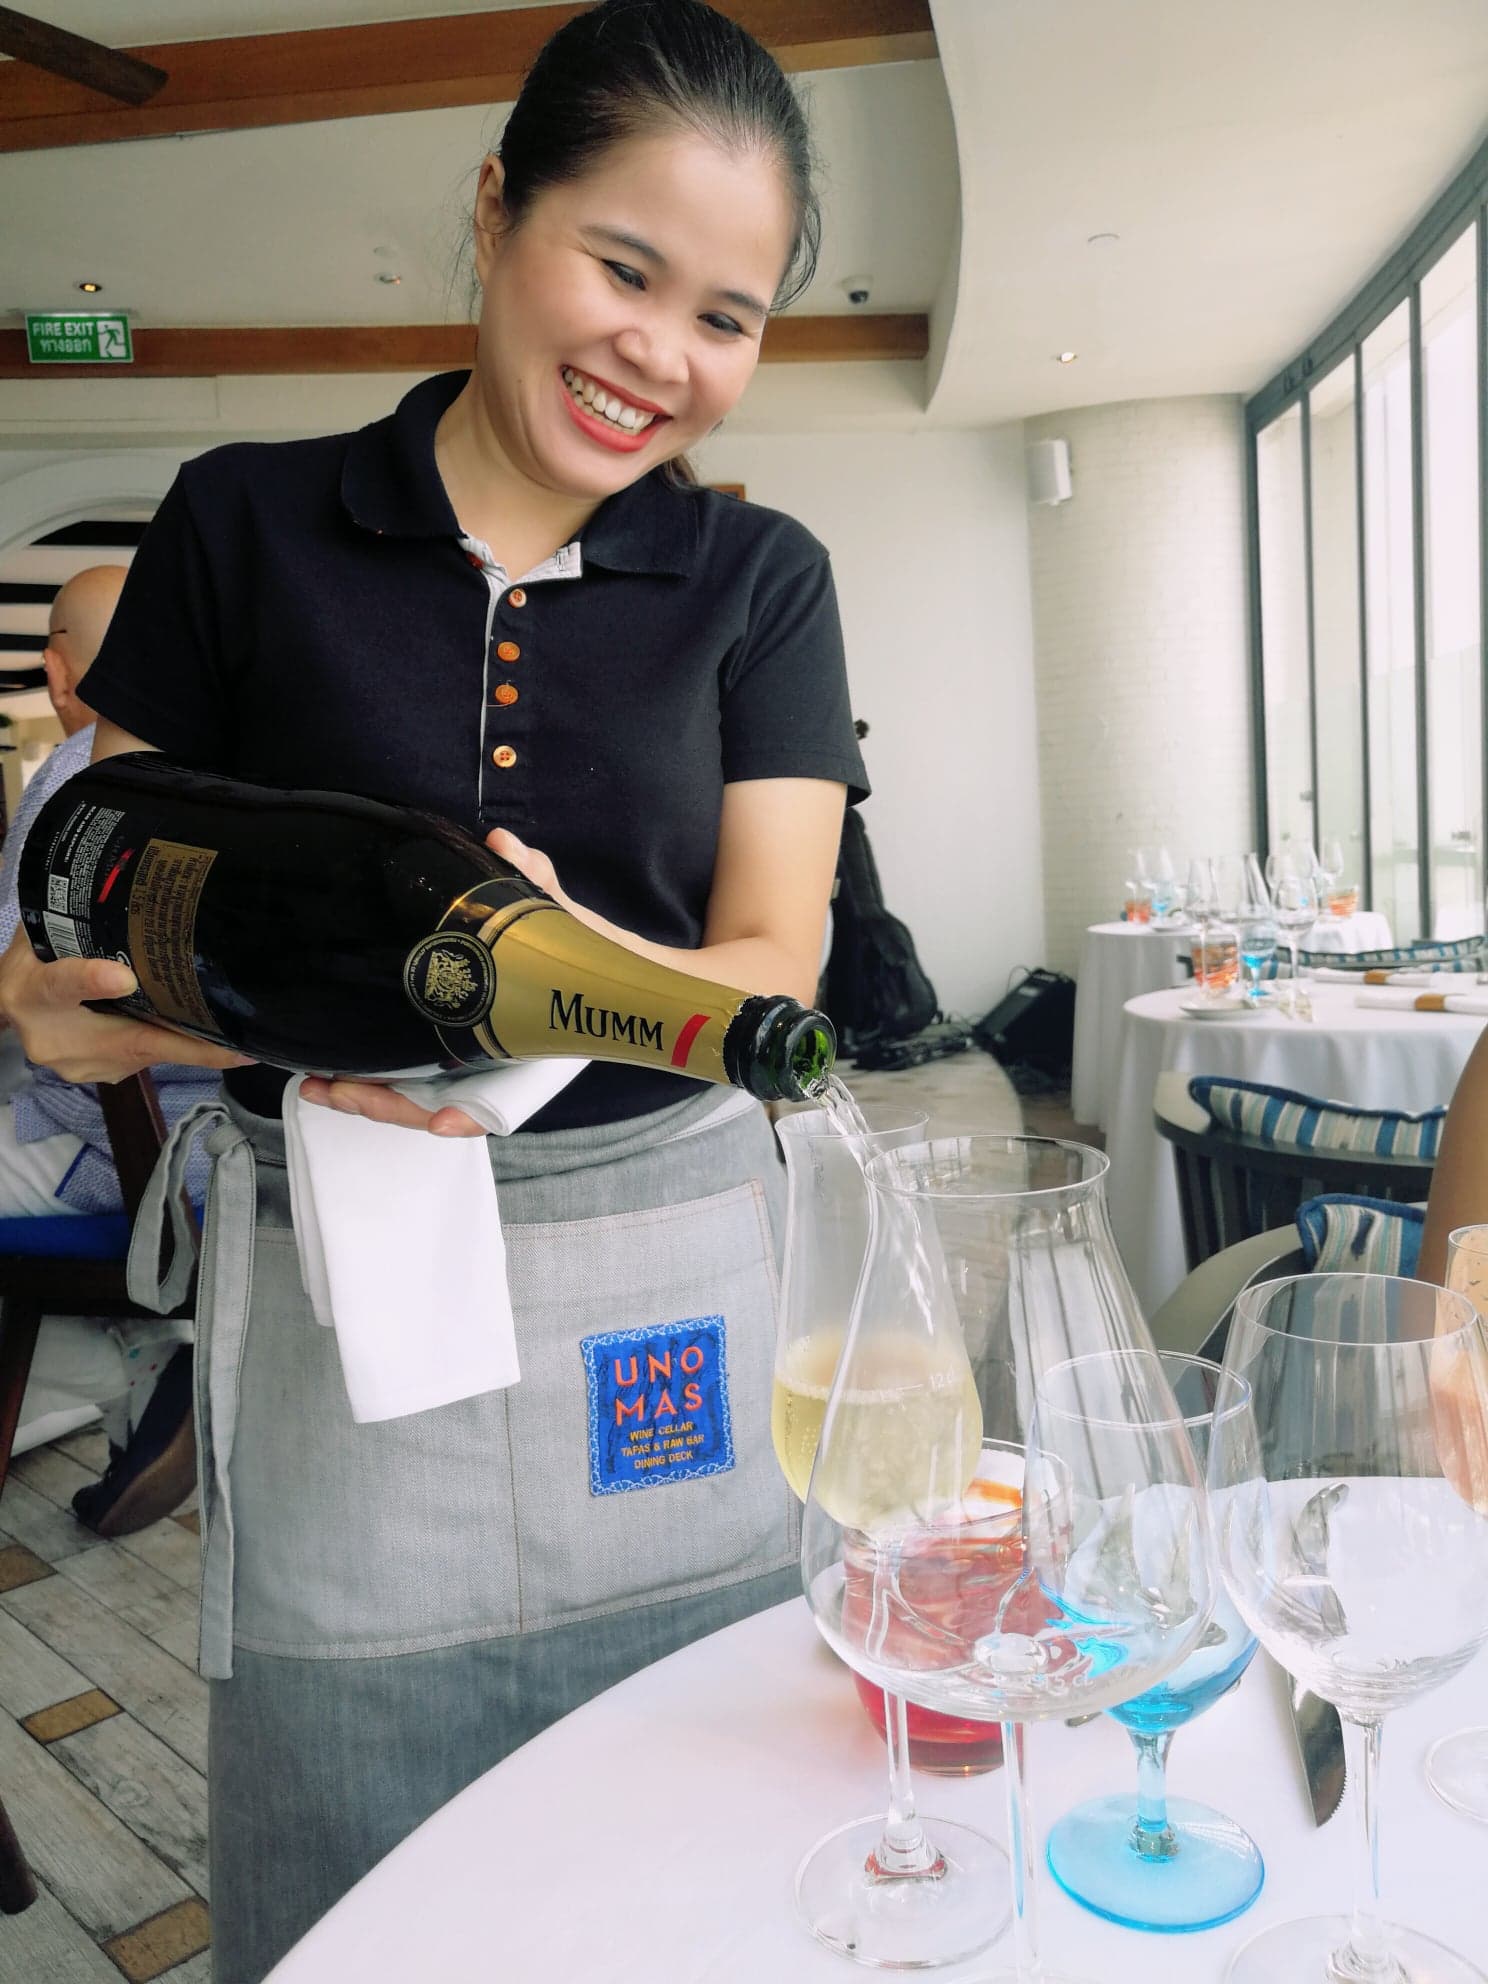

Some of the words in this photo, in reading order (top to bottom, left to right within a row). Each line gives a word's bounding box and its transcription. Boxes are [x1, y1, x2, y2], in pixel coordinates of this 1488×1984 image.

[32, 322, 62, 337] FIRE
[63, 322, 94, 337] EXIT
[39, 338, 92, 353] ทางออก
[549, 989, 665, 1051] MUMM
[614, 1346, 704, 1387] UNO
[614, 1383, 703, 1427] MAS
[629, 1427, 655, 1442] WINE
[658, 1420, 694, 1436] CELLAR
[621, 1443, 651, 1457] TAPAS
[662, 1437, 684, 1450] RAW
[686, 1433, 705, 1446] BAR
[633, 1455, 666, 1470] DINING
[668, 1450, 694, 1464] DECK
